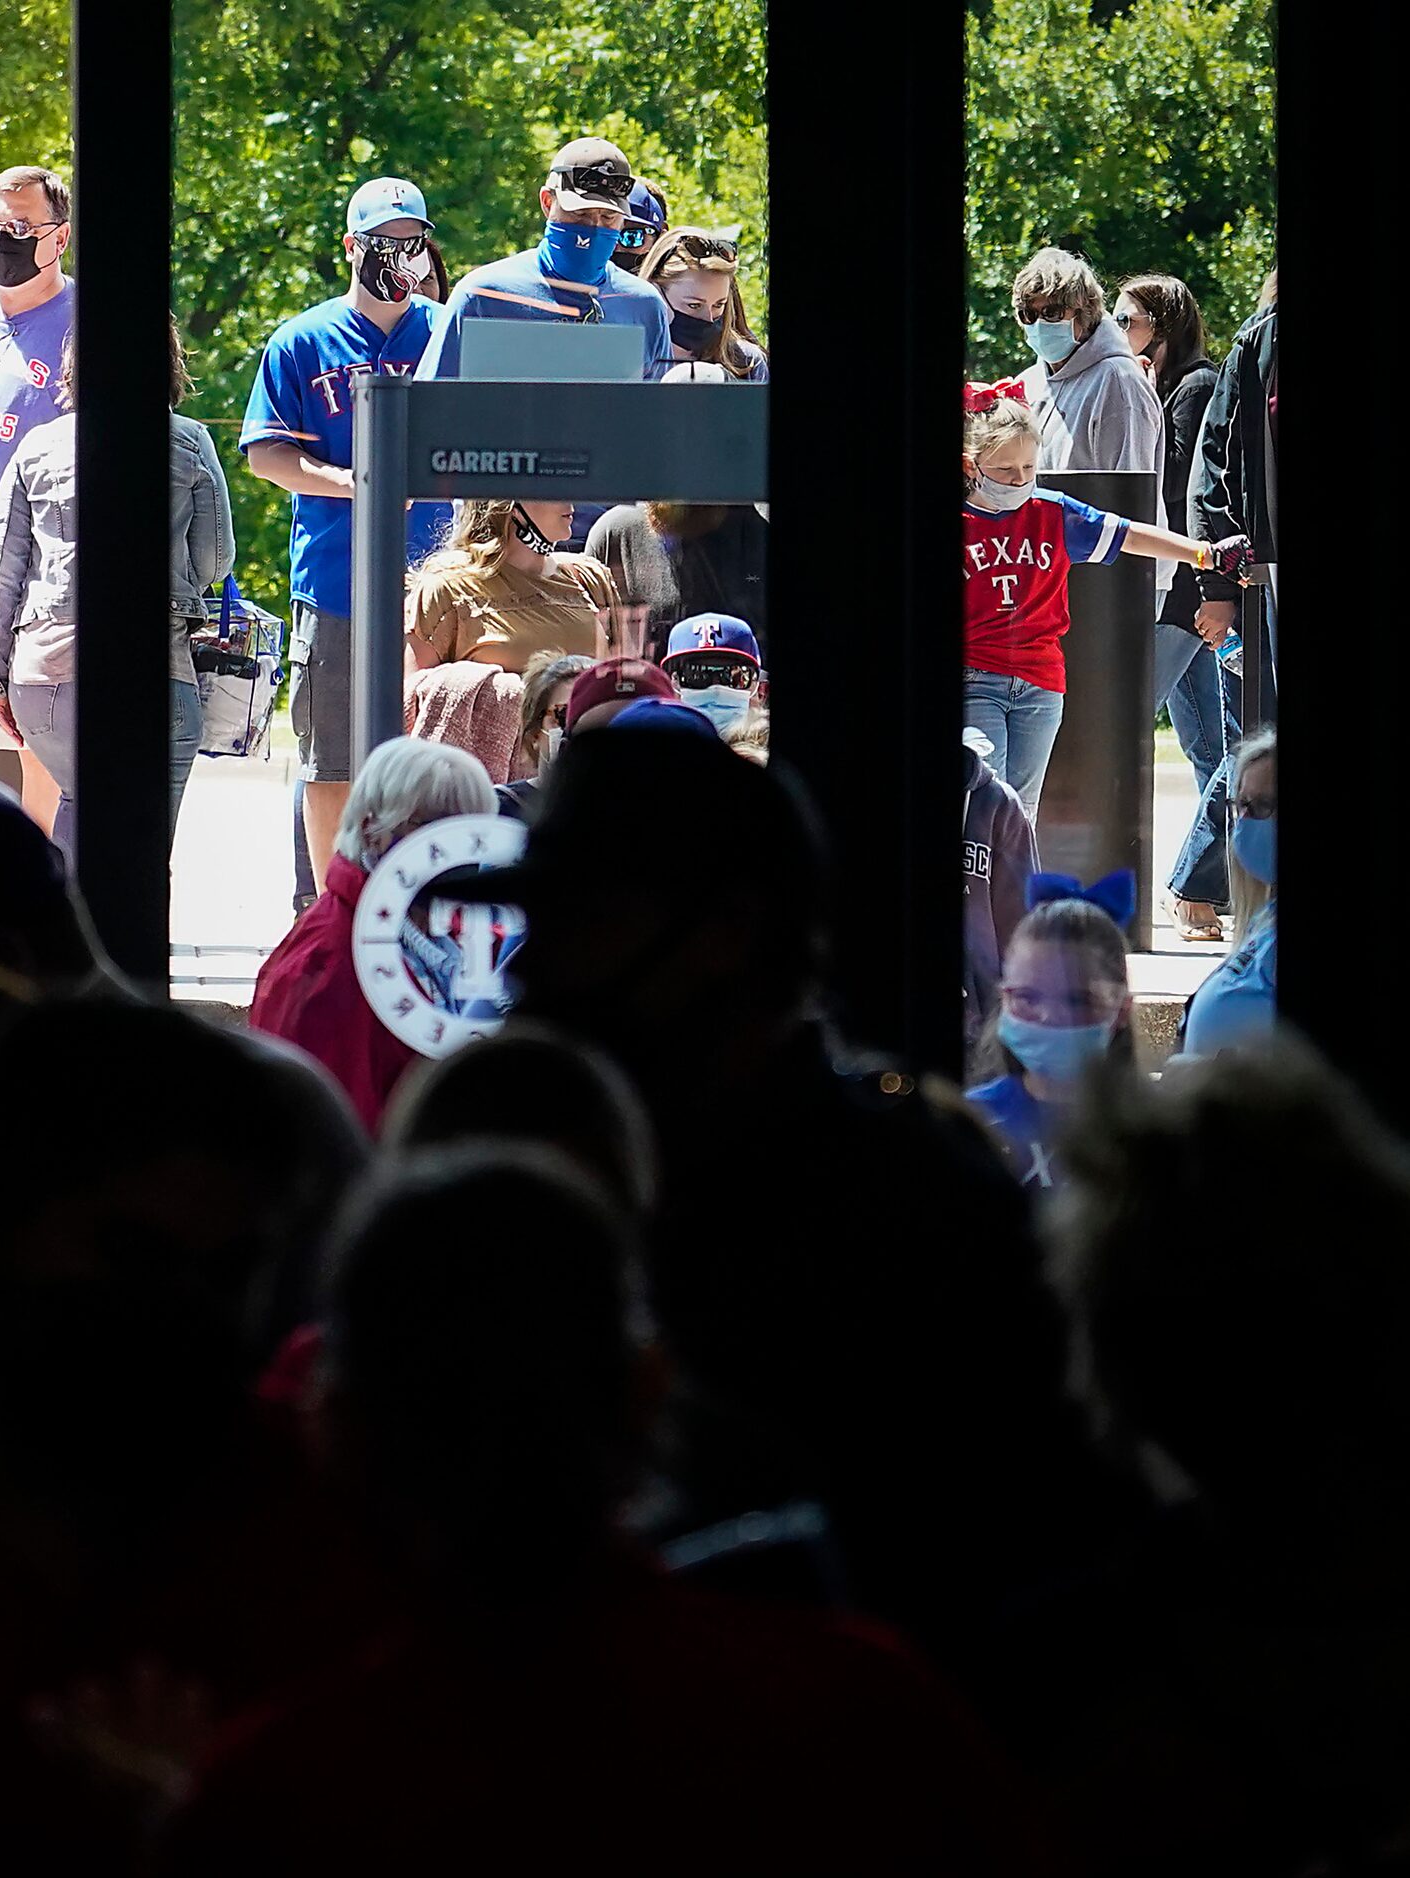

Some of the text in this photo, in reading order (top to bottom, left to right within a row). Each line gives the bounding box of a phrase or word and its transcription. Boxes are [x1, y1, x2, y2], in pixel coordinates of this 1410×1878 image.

[430, 450, 539, 474] GARRETT
[962, 536, 1053, 580] EXAS
[991, 574, 1018, 605] T
[692, 619, 722, 648] T
